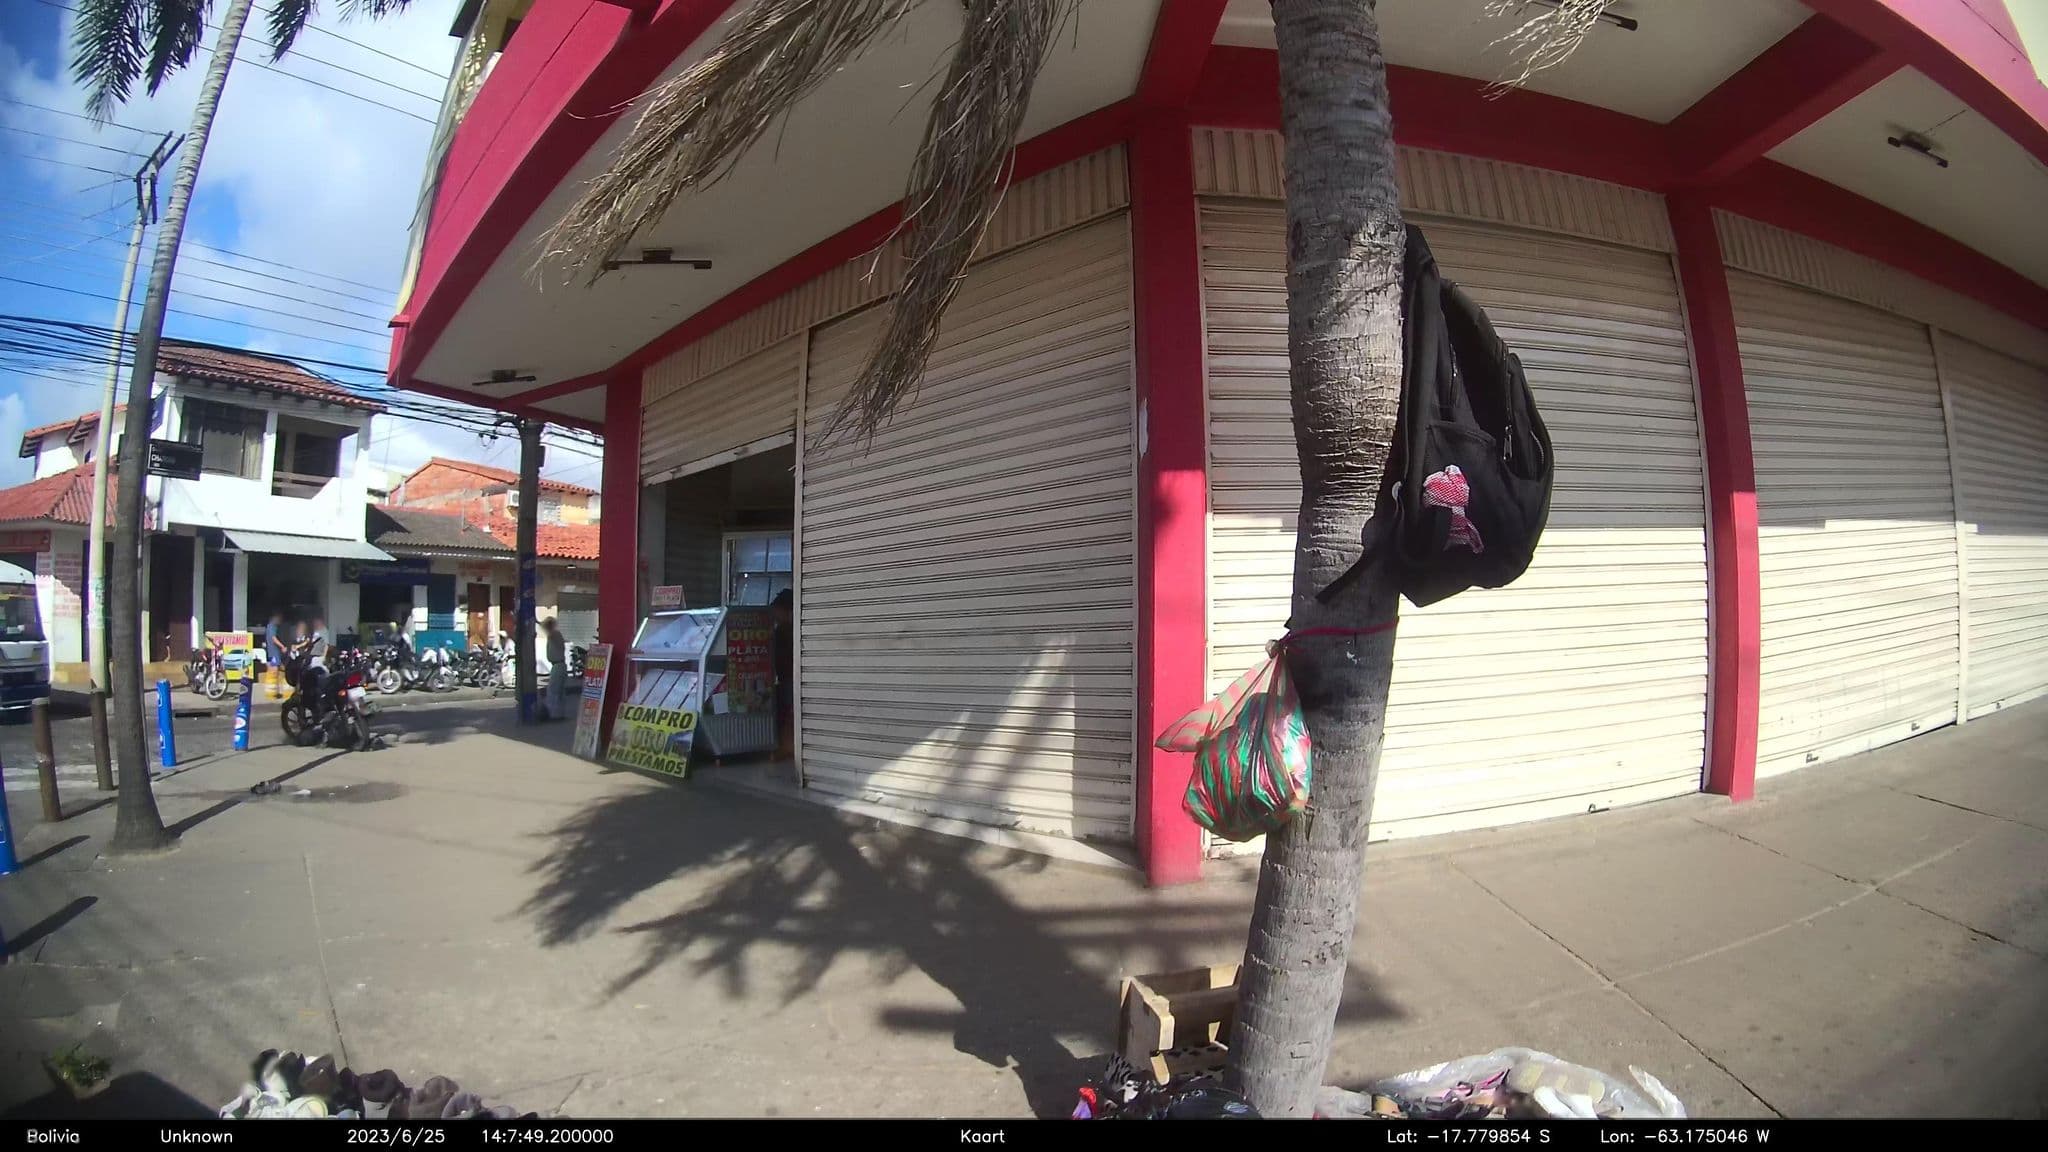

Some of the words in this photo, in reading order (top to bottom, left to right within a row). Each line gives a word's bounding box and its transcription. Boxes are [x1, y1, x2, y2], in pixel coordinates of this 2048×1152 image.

[728, 629, 769, 640] ORO
[728, 646, 768, 656] PLATA
[586, 656, 606, 669] ORO
[624, 706, 693, 729] COMPRO
[631, 724, 667, 755] ORO
[608, 748, 684, 775] PRESTAMOS
